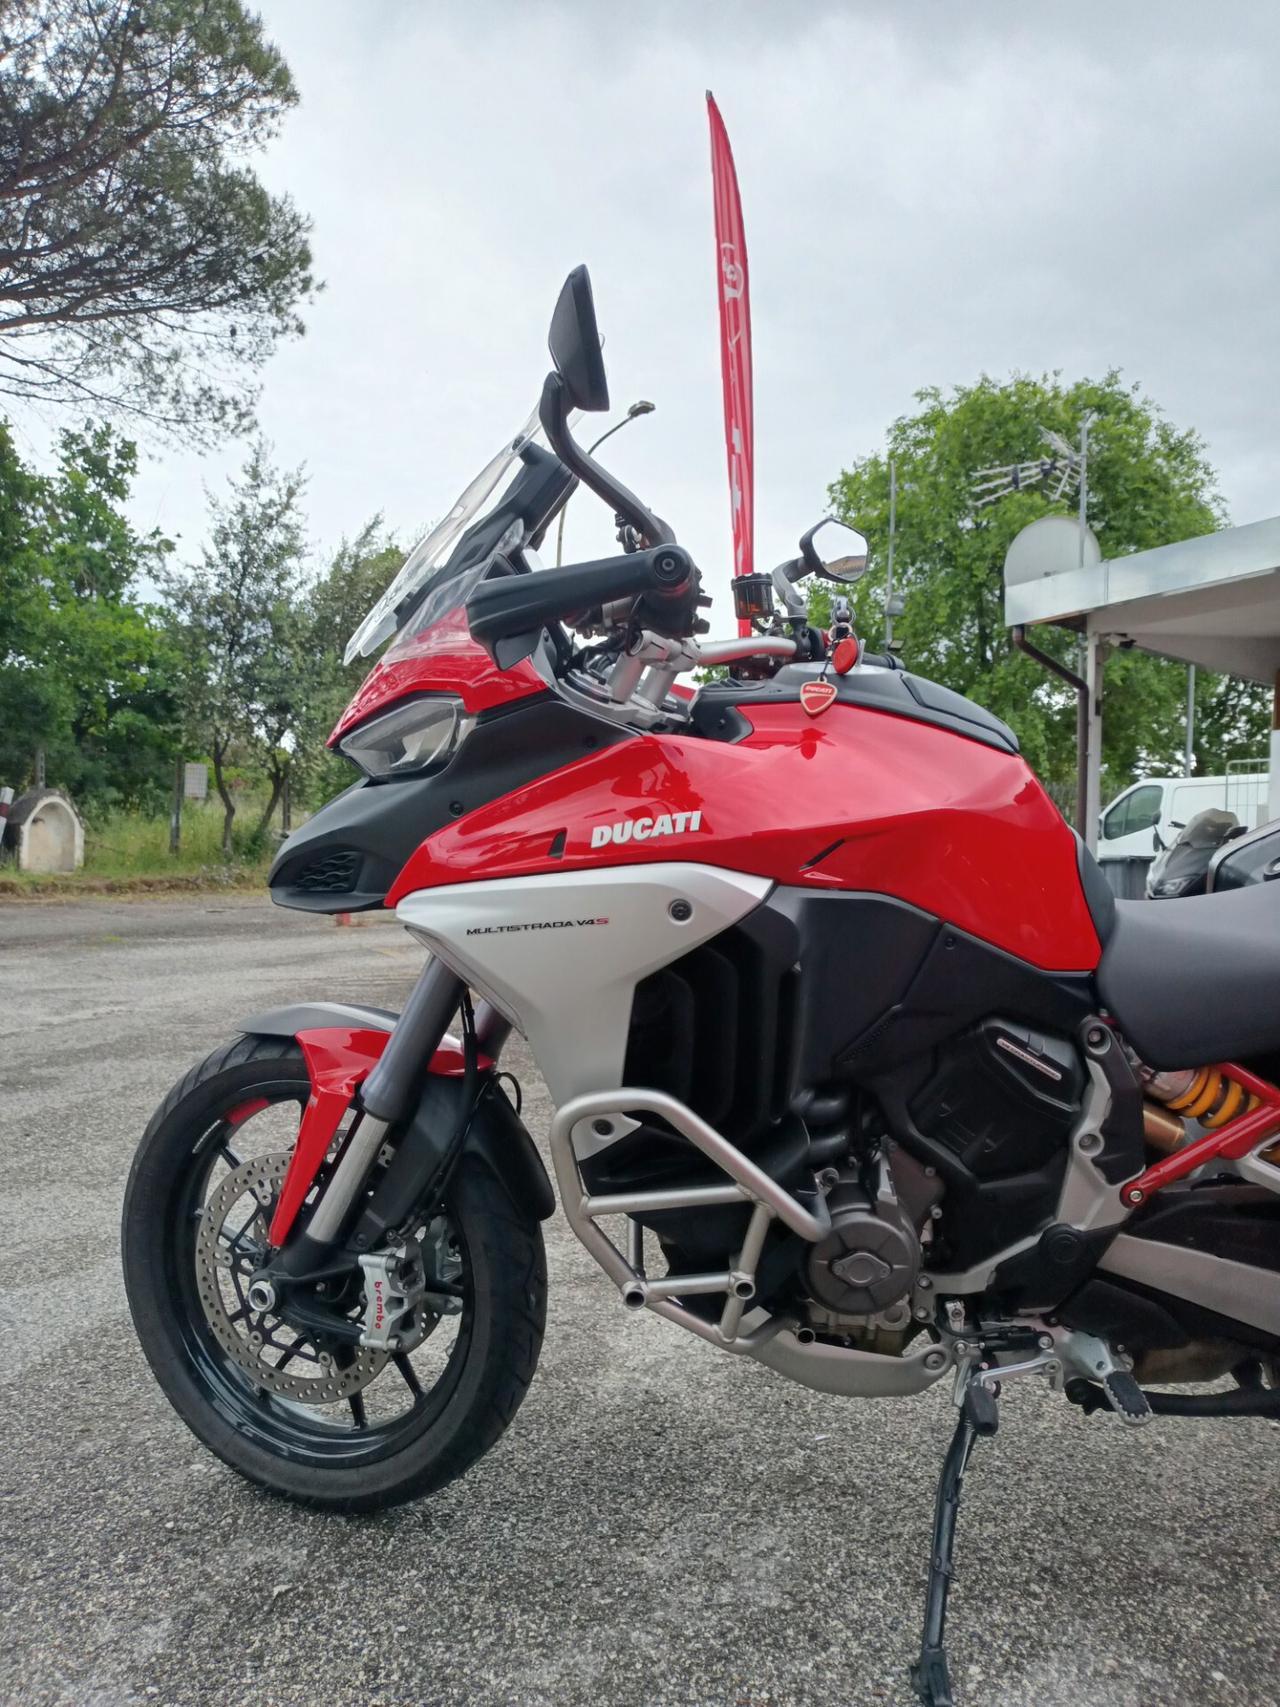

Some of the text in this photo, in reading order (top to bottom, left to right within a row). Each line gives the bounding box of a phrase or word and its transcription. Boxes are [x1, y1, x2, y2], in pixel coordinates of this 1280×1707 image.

[805, 685, 833, 694] DUCATI
[591, 811, 702, 848] DUCATI
[466, 918, 609, 935] MULTISTRADA V4S
[374, 1281, 385, 1329] brembo
